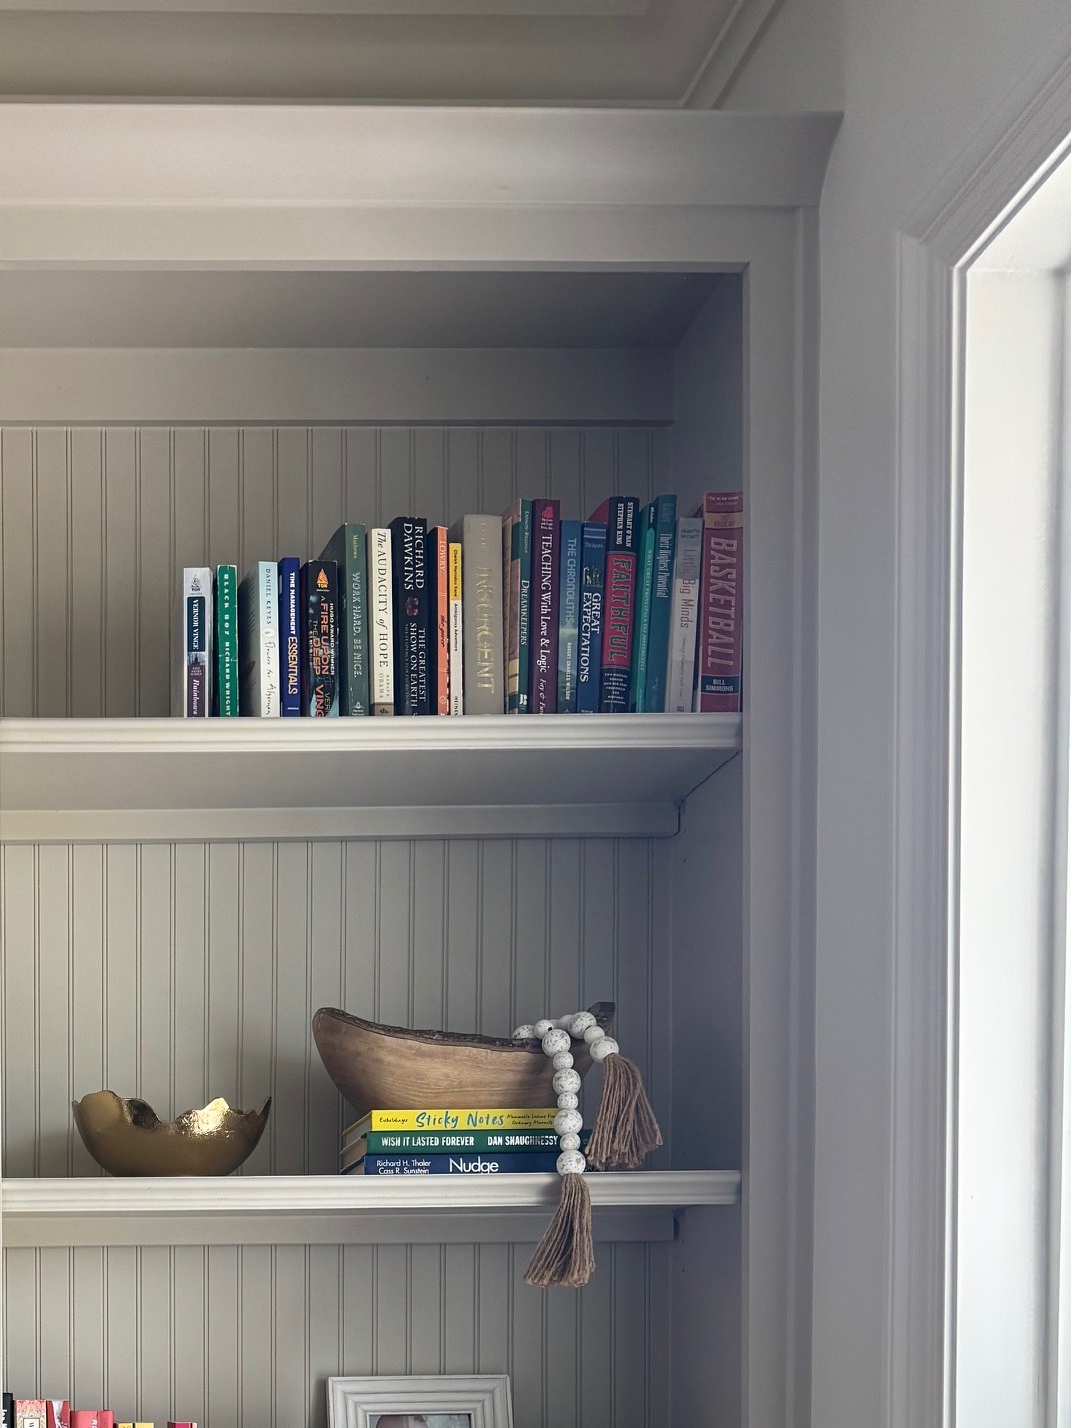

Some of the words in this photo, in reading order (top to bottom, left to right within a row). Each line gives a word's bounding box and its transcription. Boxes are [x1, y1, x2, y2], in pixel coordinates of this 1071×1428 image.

[377, 532, 387, 549] The
[568, 538, 577, 558] THE
[403, 522, 414, 591] DAWKINS
[415, 525, 425, 590] RICHARD
[437, 540, 445, 572] LOWRY
[541, 534, 553, 592] TEACHING
[684, 548, 697, 574] Little
[353, 572, 361, 603] WORK
[378, 552, 387, 614] AUDACITY
[565, 558, 577, 624] CHRONOLITHS
[680, 578, 696, 595] Big
[541, 592, 552, 615] With
[591, 592, 602, 634] GREAT
[609, 558, 632, 662] FAITHFUL
[680, 598, 695, 628] Minds
[707, 536, 738, 668] BASKETBALL
[353, 606, 361, 636] HARD.
[376, 618, 385, 631] of
[475, 567, 495, 693] INSURGENT
[541, 616, 551, 636] Love
[353, 638, 361, 650] BE
[379, 634, 389, 668] HOPE
[409, 622, 417, 654] SHOW
[541, 638, 550, 647] &
[579, 592, 593, 682] EXPECTATIONS
[287, 636, 298, 695] ESSENTIALS
[353, 652, 362, 678] NICE.
[410, 655, 417, 672] ON
[537, 650, 552, 673] Logic
[419, 650, 427, 702] GREATEST
[705, 684, 733, 692] SIMMONS
[416, 1111, 459, 1129] Sticky
[467, 1111, 504, 1127] Notes
[381, 1137, 400, 1146] WISH
[402, 1137, 411, 1146] IT
[412, 1136, 439, 1146] LASTED
[442, 1136, 475, 1146] FOREVER
[487, 1136, 503, 1146] DAN
[505, 1135, 559, 1146] SHAUGHNESSY
[412, 1159, 431, 1167] Thaler
[449, 1156, 499, 1174] Nudge
